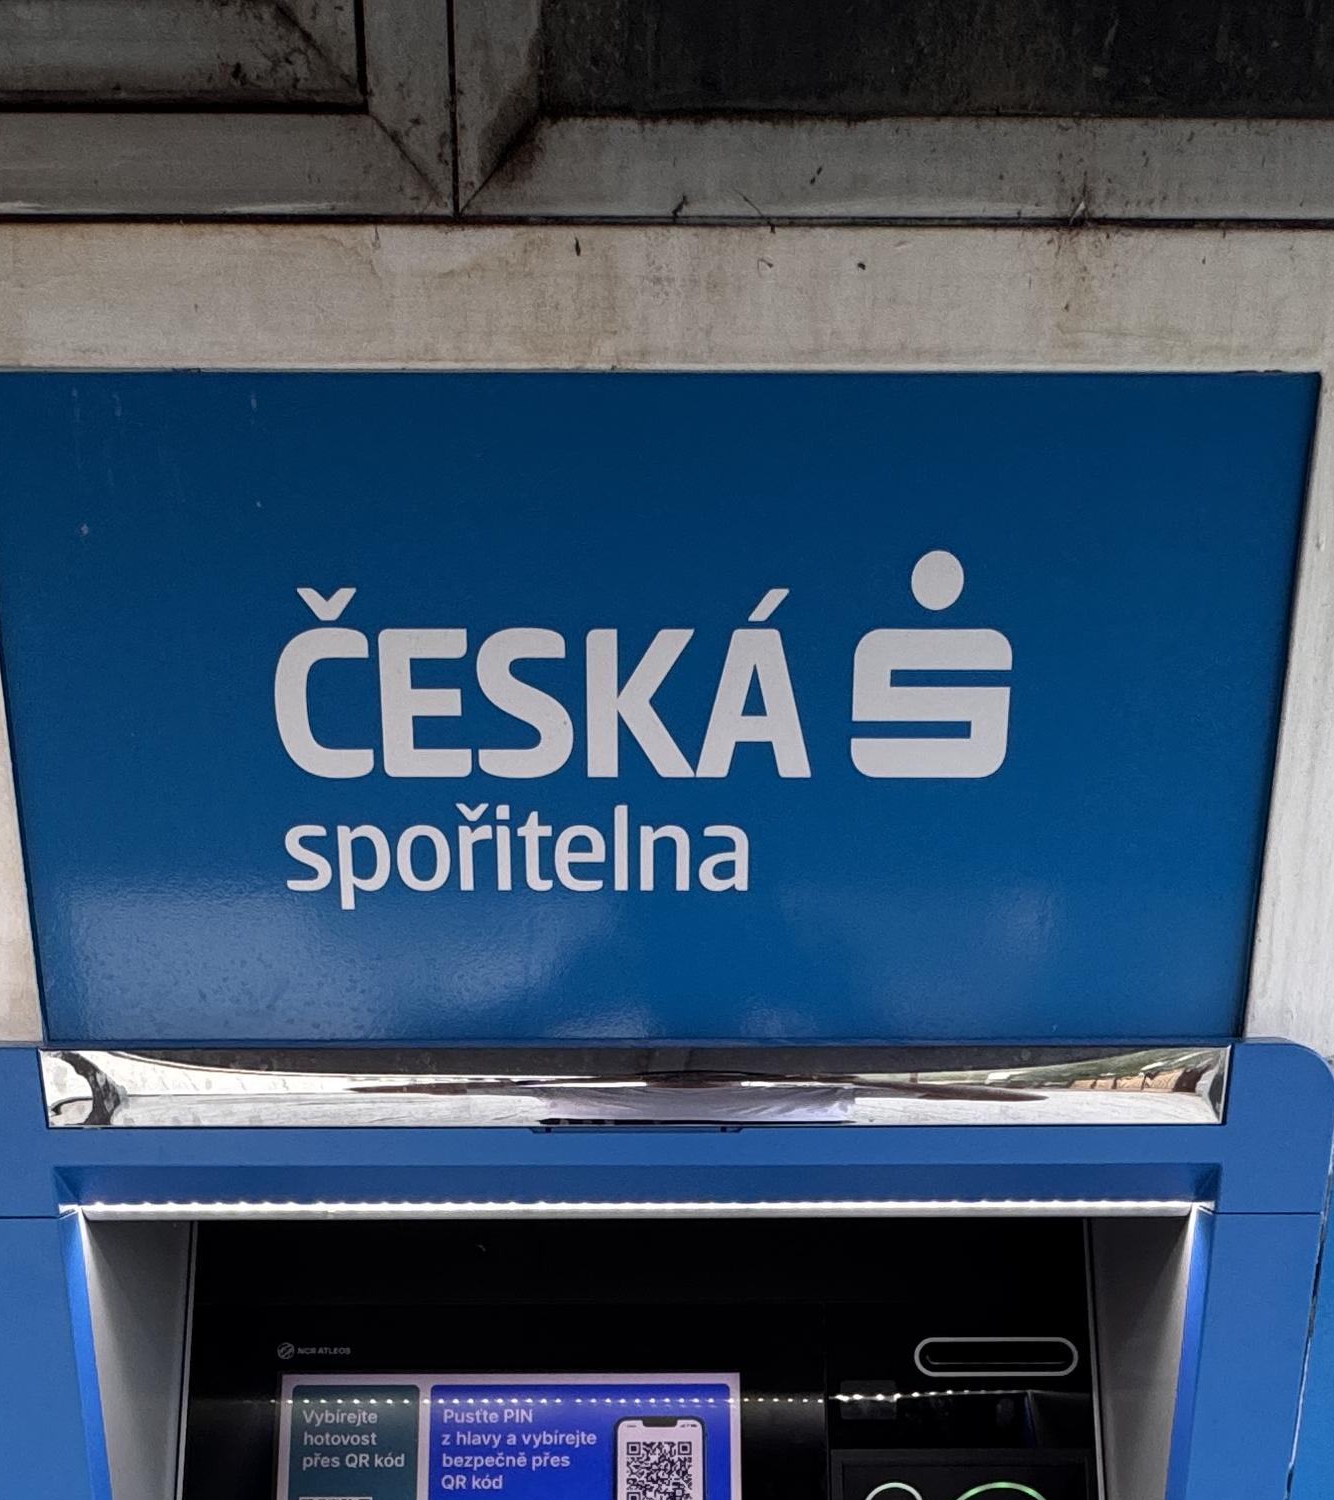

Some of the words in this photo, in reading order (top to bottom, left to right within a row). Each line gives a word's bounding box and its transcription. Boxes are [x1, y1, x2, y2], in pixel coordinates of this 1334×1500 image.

[274, 586, 813, 779] ČESKÁ
[283, 802, 751, 910] spořitelna
[302, 1408, 378, 1427] Vybírejte
[442, 1408, 499, 1424] Pusťte
[503, 1408, 534, 1424] PIN
[303, 1431, 378, 1446] hotovost
[441, 1433, 451, 1446] z
[456, 1430, 502, 1448] hlavy
[506, 1433, 517, 1446] a
[522, 1430, 598, 1448] vybírejte
[302, 1452, 340, 1471] přes
[345, 1453, 370, 1468] QR
[374, 1452, 405, 1468] kód
[442, 1452, 528, 1471] bezpečně
[532, 1452, 571, 1471] přes
[441, 1474, 467, 1490] QR
[471, 1474, 504, 1490] kód
